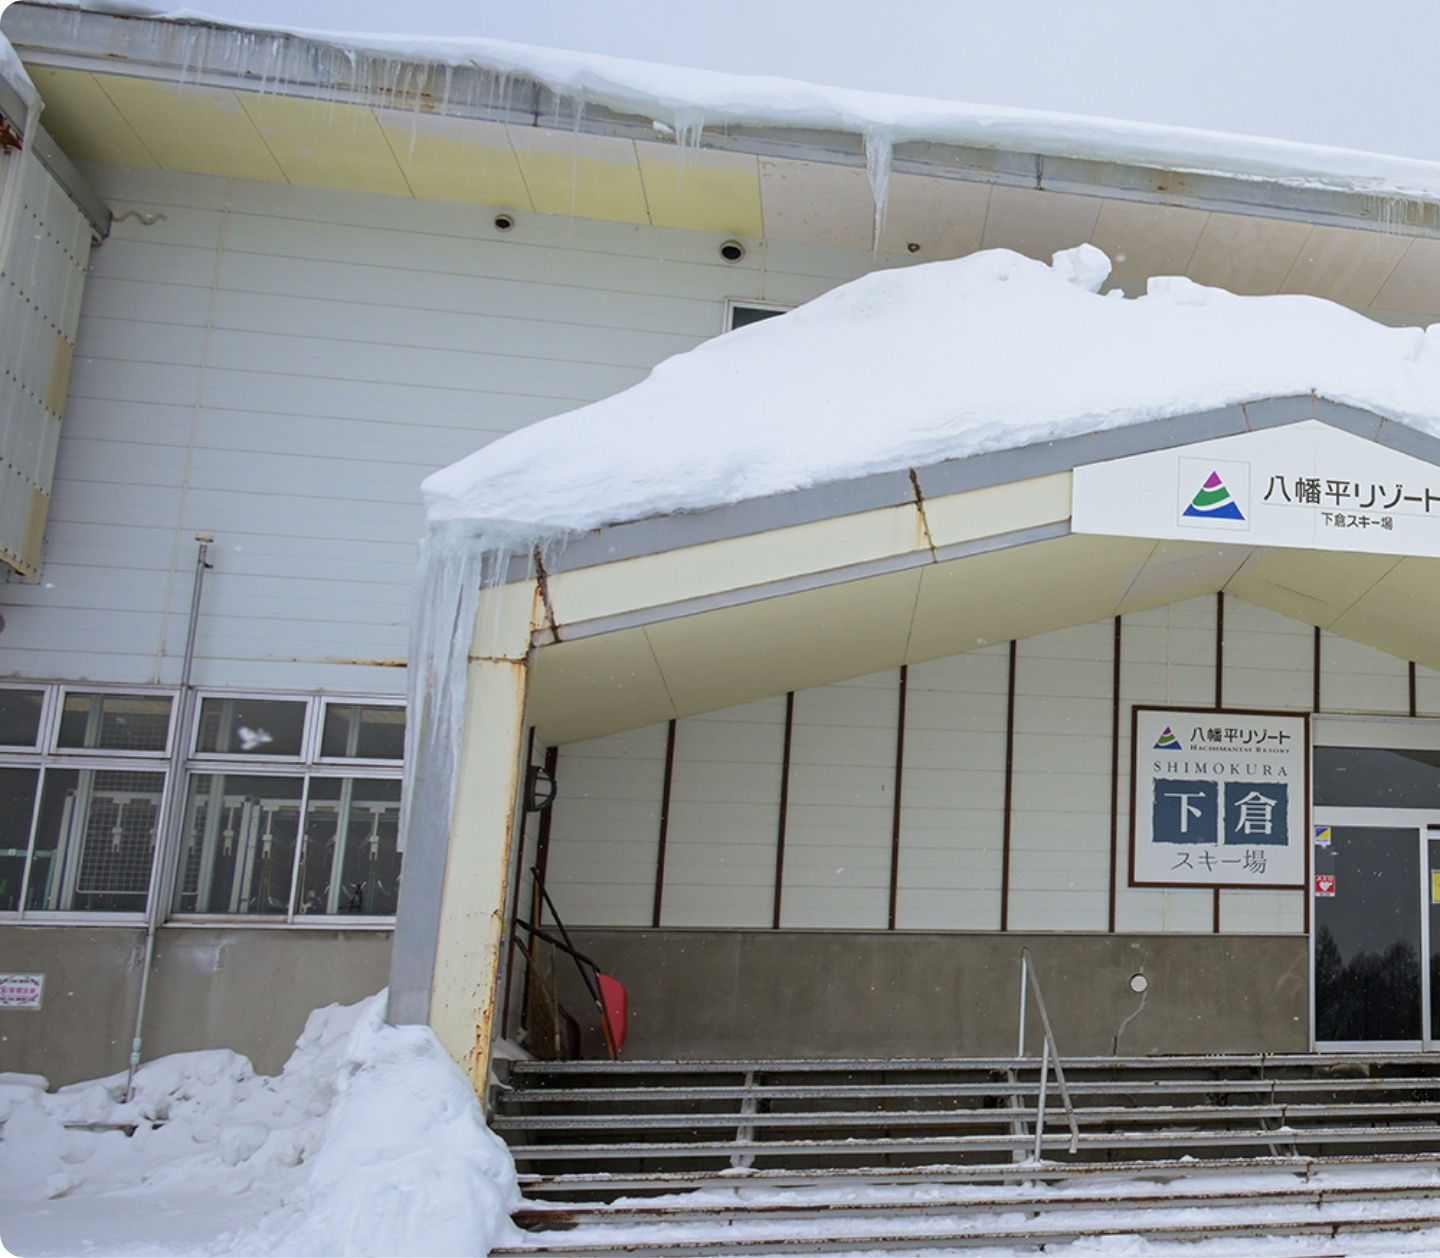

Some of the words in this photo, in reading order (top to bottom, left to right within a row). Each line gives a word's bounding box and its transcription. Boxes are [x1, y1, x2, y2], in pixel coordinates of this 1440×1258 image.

[1321, 511, 1393, 531] 下倉スキー場
[1190, 726, 1291, 746] 八幡平リゾート
[1153, 760, 1288, 777] SHIMOKURA
[1163, 790, 1279, 835] 下倉
[1170, 849, 1268, 875] スキー場
